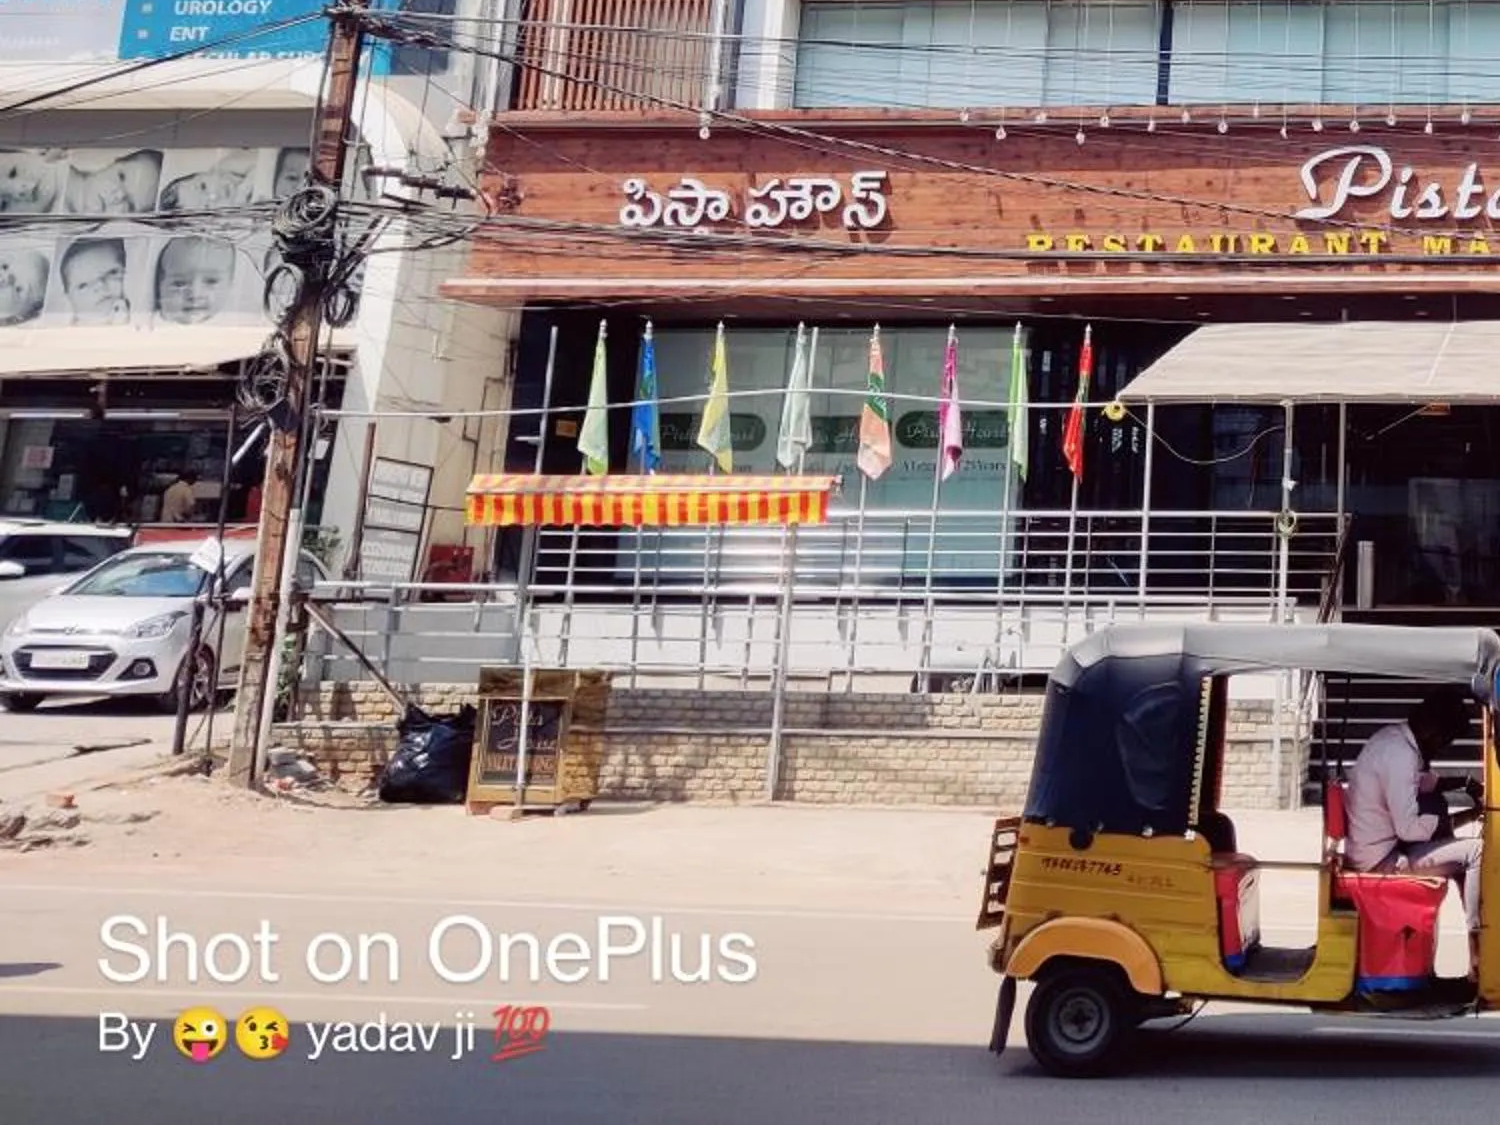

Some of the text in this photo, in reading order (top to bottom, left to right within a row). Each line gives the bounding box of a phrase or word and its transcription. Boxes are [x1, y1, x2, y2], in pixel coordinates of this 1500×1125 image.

[174, 0, 272, 15] UROLOGY
[169, 26, 208, 42] ENT
[1027, 232, 1388, 255] RESTAURANT
